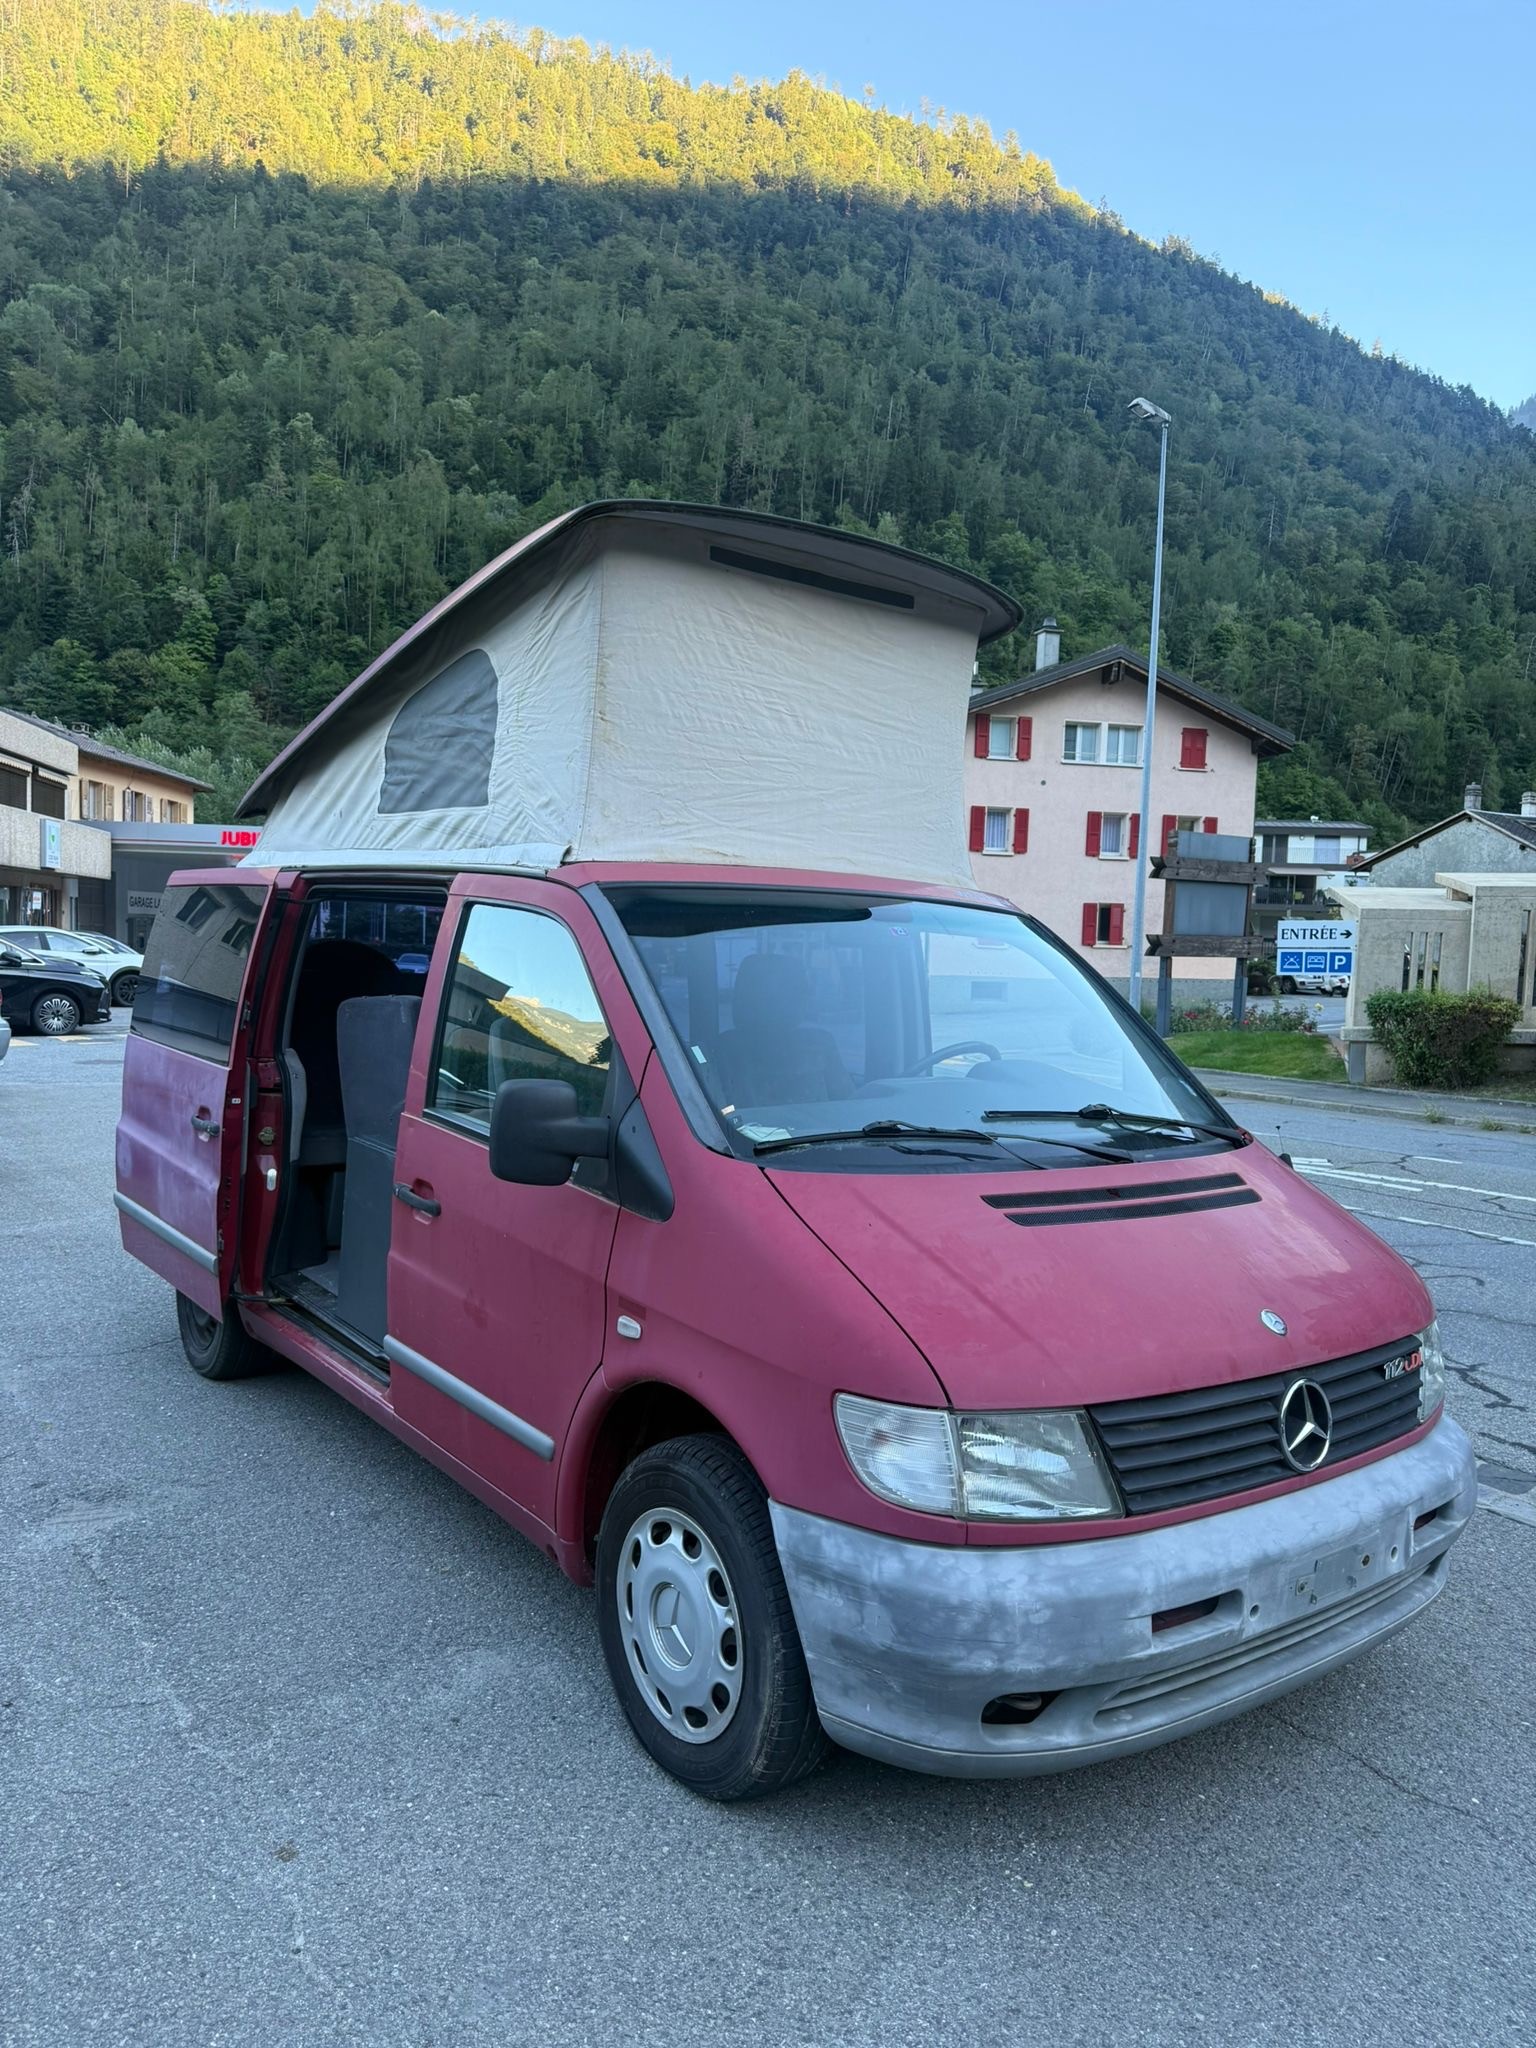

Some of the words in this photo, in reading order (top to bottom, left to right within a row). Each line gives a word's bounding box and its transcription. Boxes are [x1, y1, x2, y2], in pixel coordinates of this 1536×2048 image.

[221, 831, 261, 846] JUBI
[129, 896, 153, 908] GARAGE
[1281, 925, 1338, 940] ENTRÉE
[1334, 955, 1347, 970] P
